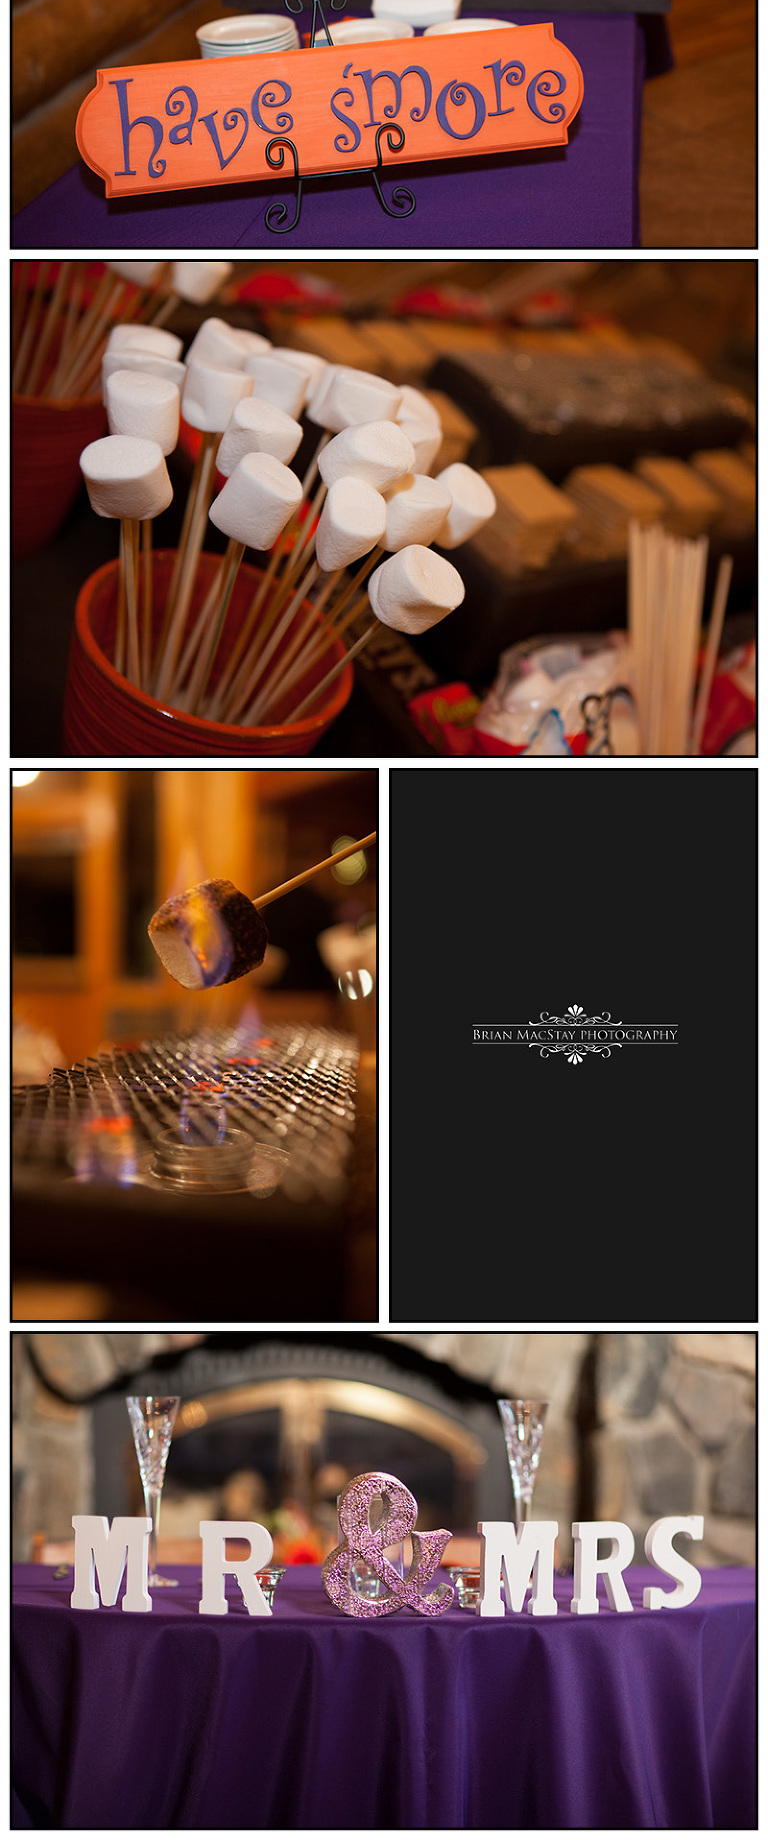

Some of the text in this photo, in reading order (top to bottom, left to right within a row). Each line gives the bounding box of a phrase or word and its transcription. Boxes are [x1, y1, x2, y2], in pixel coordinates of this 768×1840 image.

[108, 75, 294, 179] have
[321, 1471, 455, 1618] &
[476, 1515, 704, 1617] MRS
